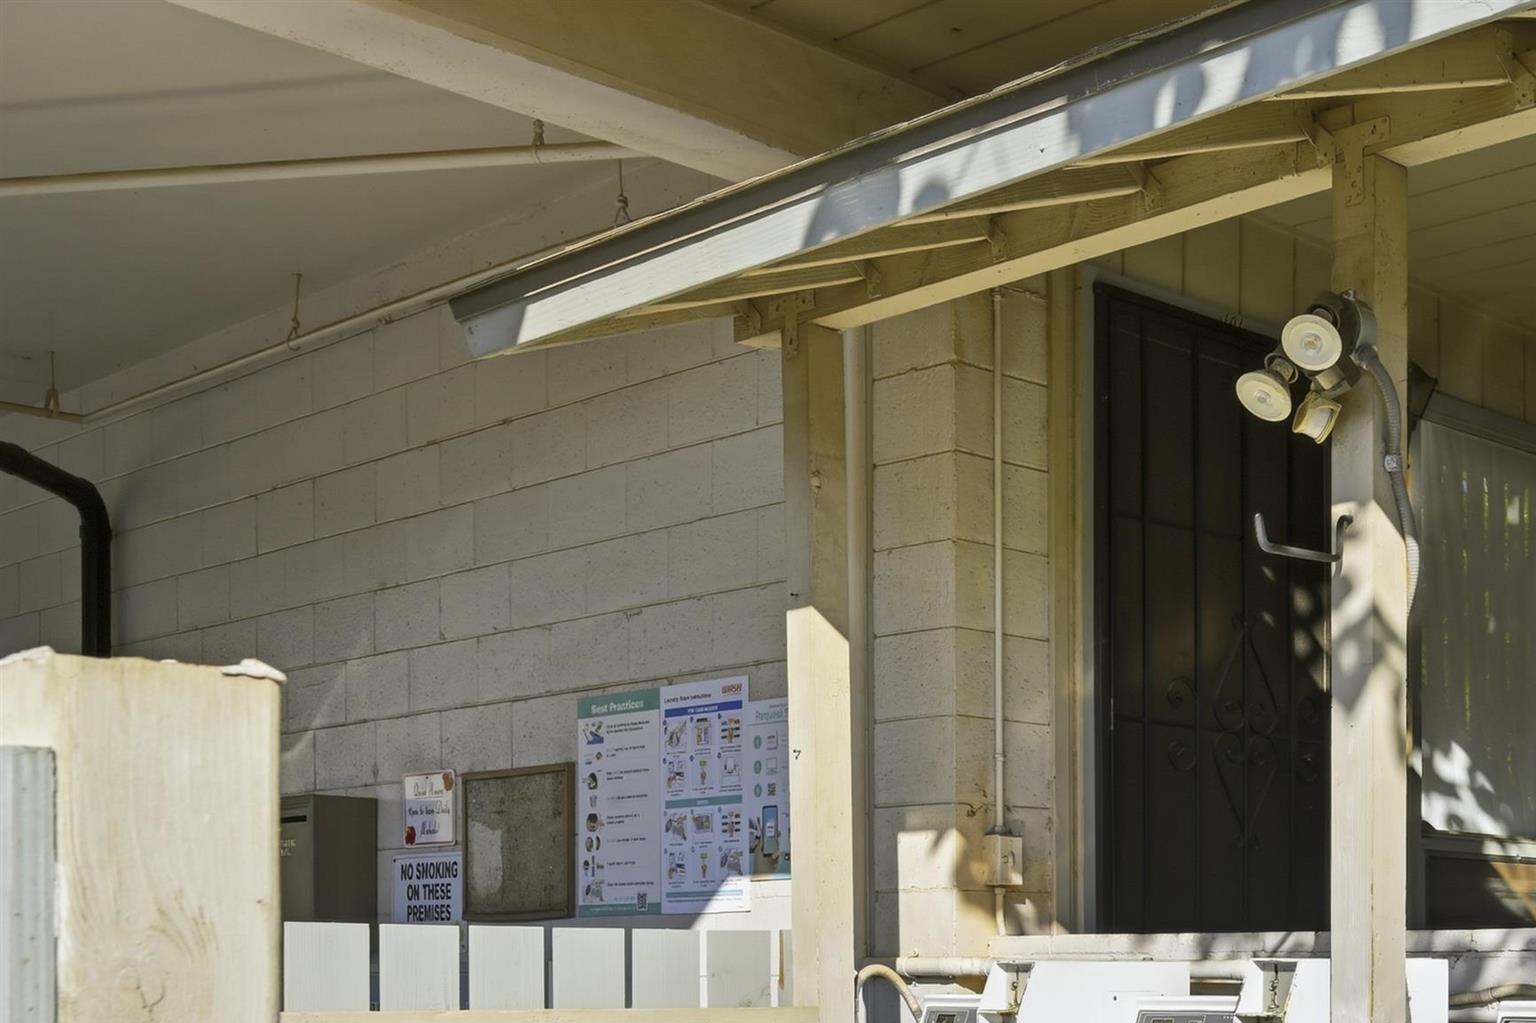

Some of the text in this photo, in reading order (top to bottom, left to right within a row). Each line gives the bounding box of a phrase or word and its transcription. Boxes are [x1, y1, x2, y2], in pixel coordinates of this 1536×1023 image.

[591, 700, 644, 714] Best Practices
[401, 861, 458, 880] NO SMOKING
[407, 883, 452, 900] ON THESE
[407, 904, 452, 922] PREMISES
